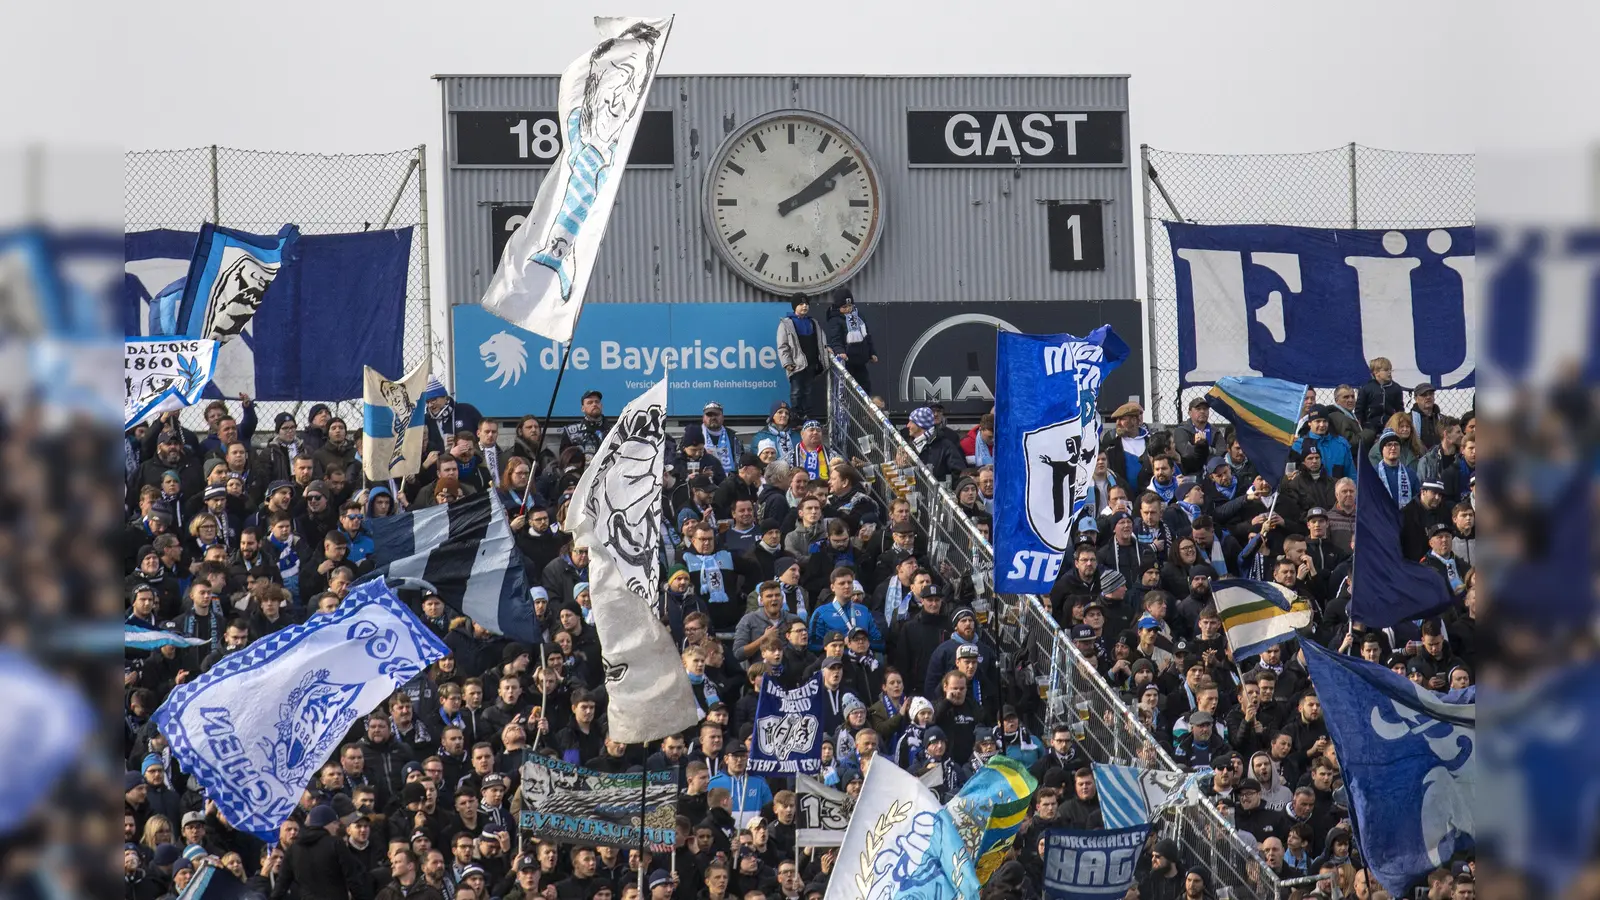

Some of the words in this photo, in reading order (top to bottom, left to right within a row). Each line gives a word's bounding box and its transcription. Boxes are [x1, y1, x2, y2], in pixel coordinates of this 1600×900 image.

[509, 118, 560, 159] 18
[944, 112, 1088, 157] GAST
[1066, 214, 1083, 261] 1
[127, 342, 199, 355] DALTONS
[539, 340, 590, 370] die
[600, 338, 777, 375] Bayerische
[625, 379, 659, 389] Versich
[669, 379, 688, 389] nach
[692, 379, 711, 389] dem
[713, 379, 777, 389] Reinheitsgebot
[912, 376, 996, 402] MA
[746, 758, 777, 771] STEHT
[778, 760, 799, 772] ZUM
